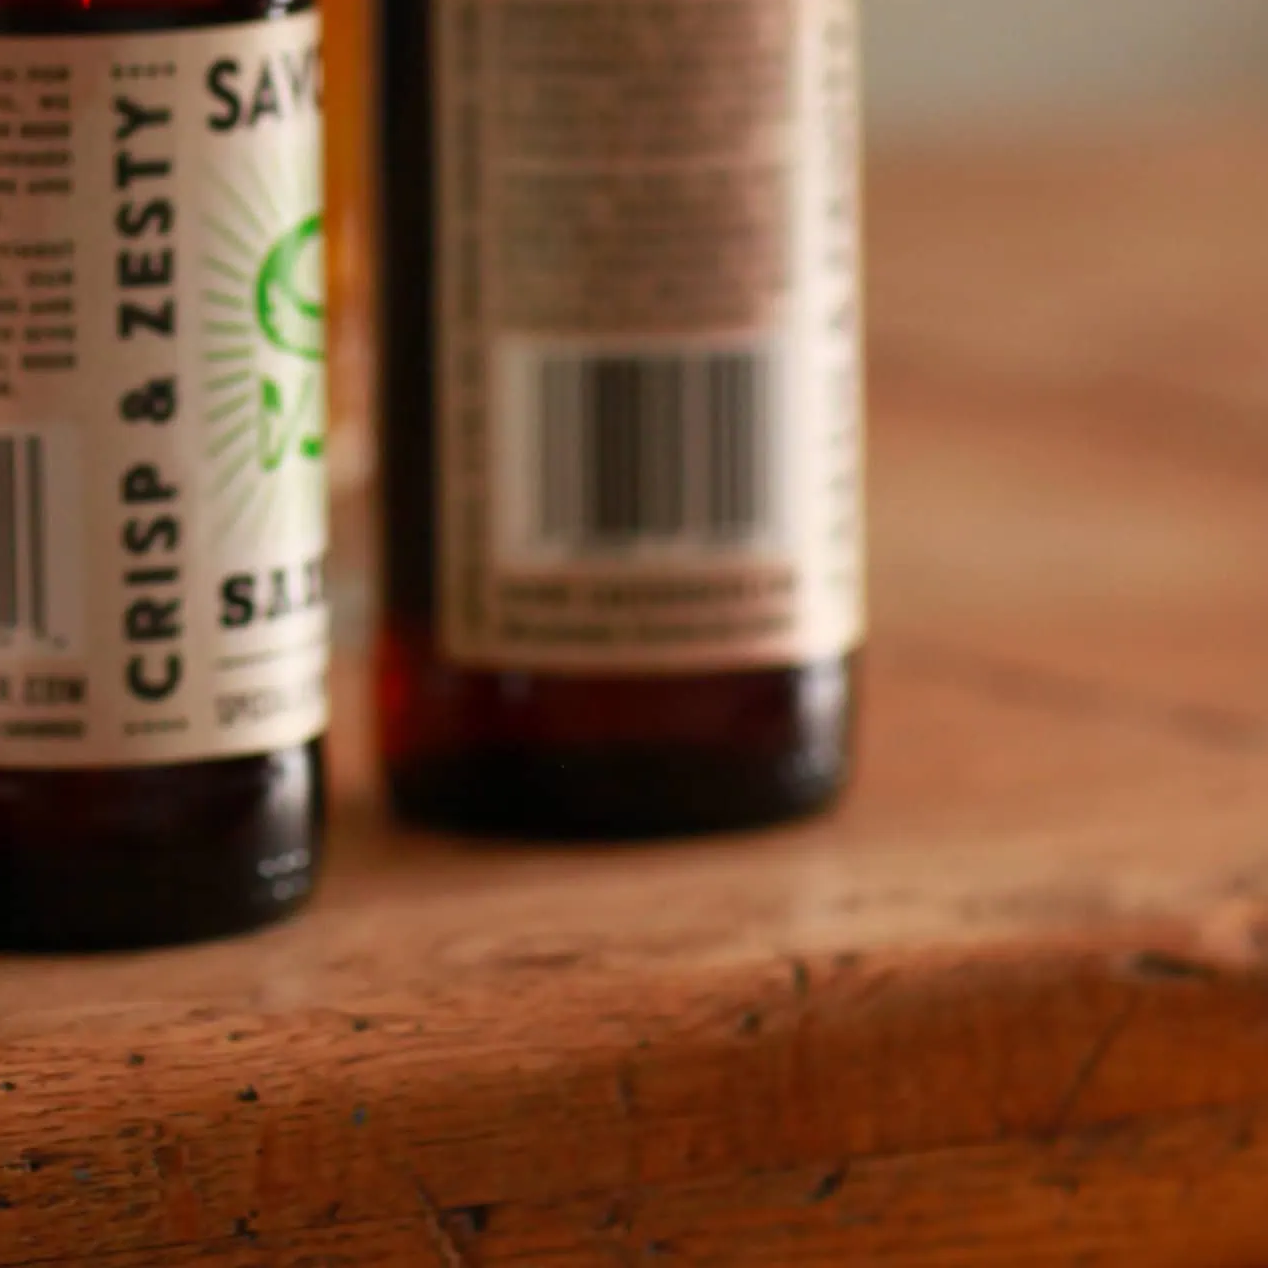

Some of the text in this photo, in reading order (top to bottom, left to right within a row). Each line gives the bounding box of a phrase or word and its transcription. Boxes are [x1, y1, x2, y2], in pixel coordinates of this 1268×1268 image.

[205, 49, 322, 131] SAV
[114, 96, 182, 701] CRISP & ZESTY
